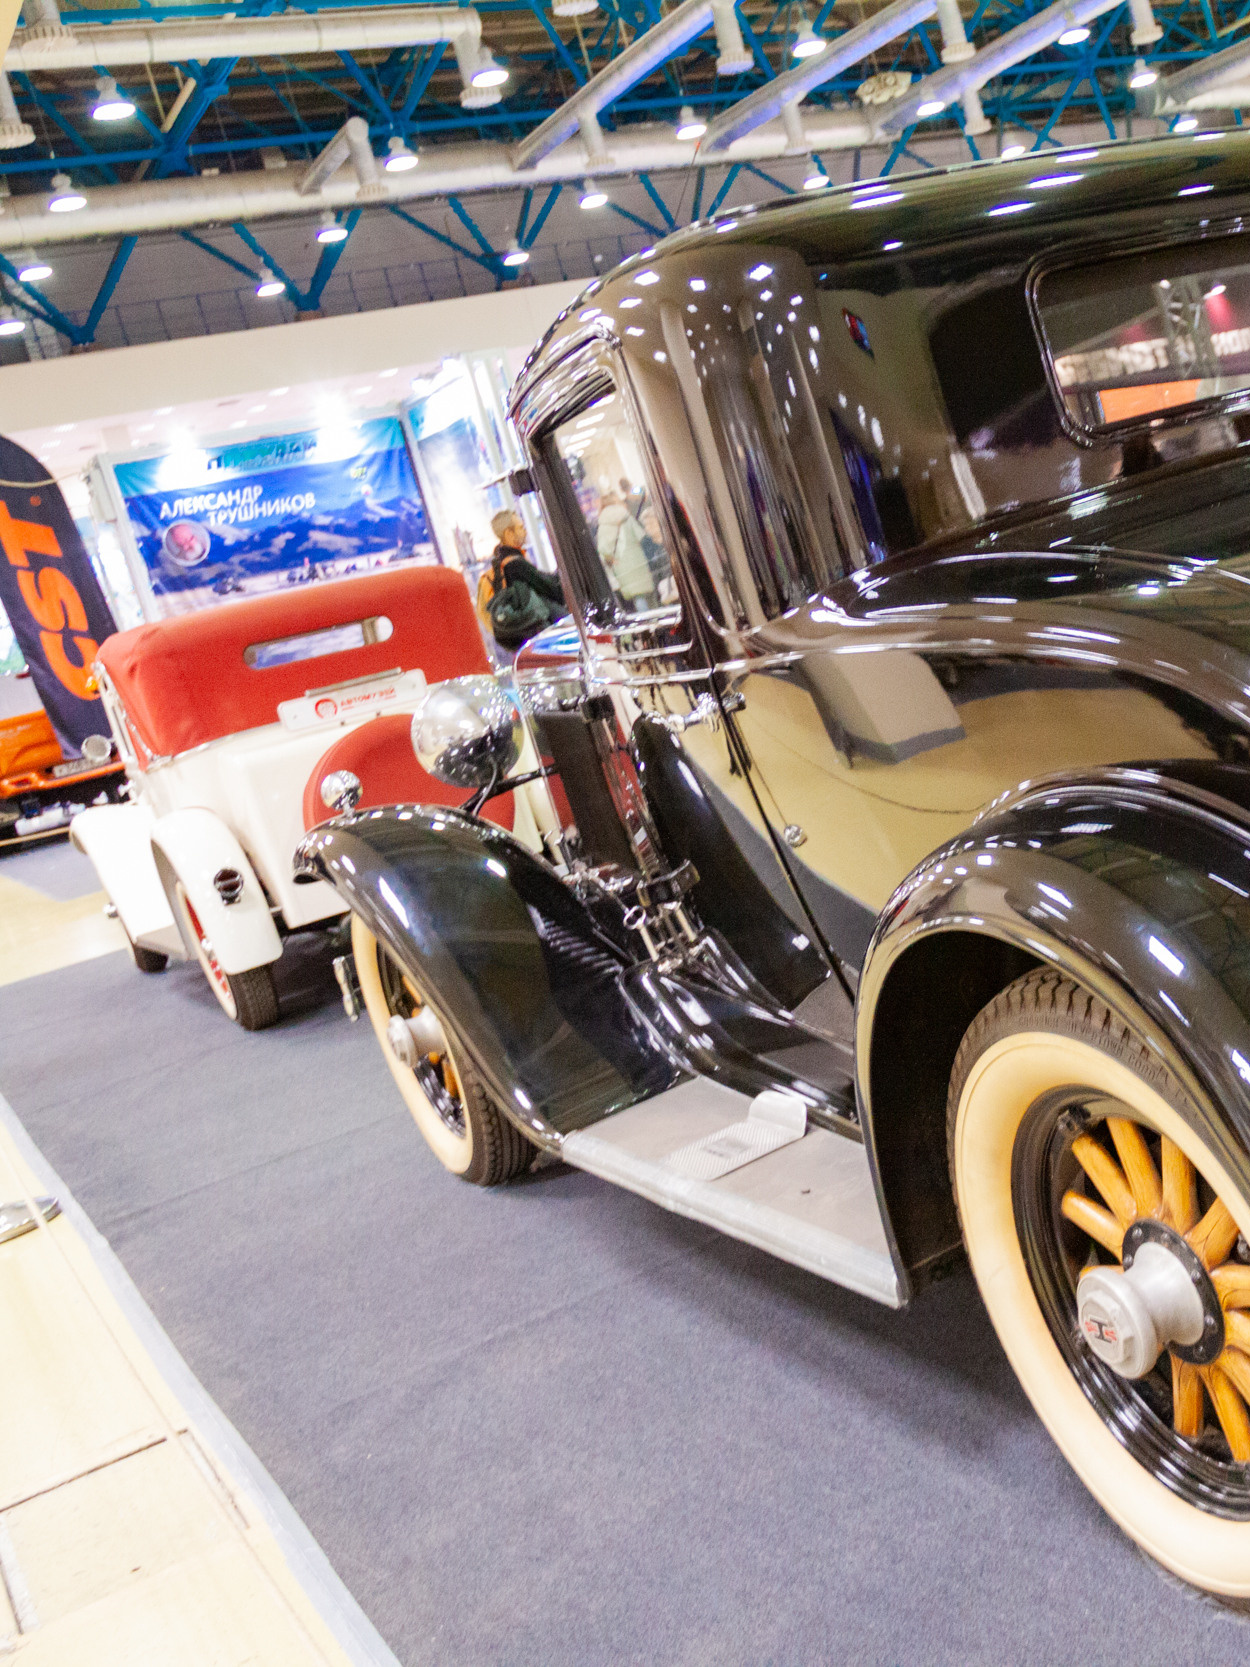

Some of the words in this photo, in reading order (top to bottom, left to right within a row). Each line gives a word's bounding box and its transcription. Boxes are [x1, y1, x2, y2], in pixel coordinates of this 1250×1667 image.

[160, 485, 263, 520] АЛЕКСАНДР
[206, 492, 316, 526] ТРУШНИКОВ
[0, 499, 101, 701] CST
